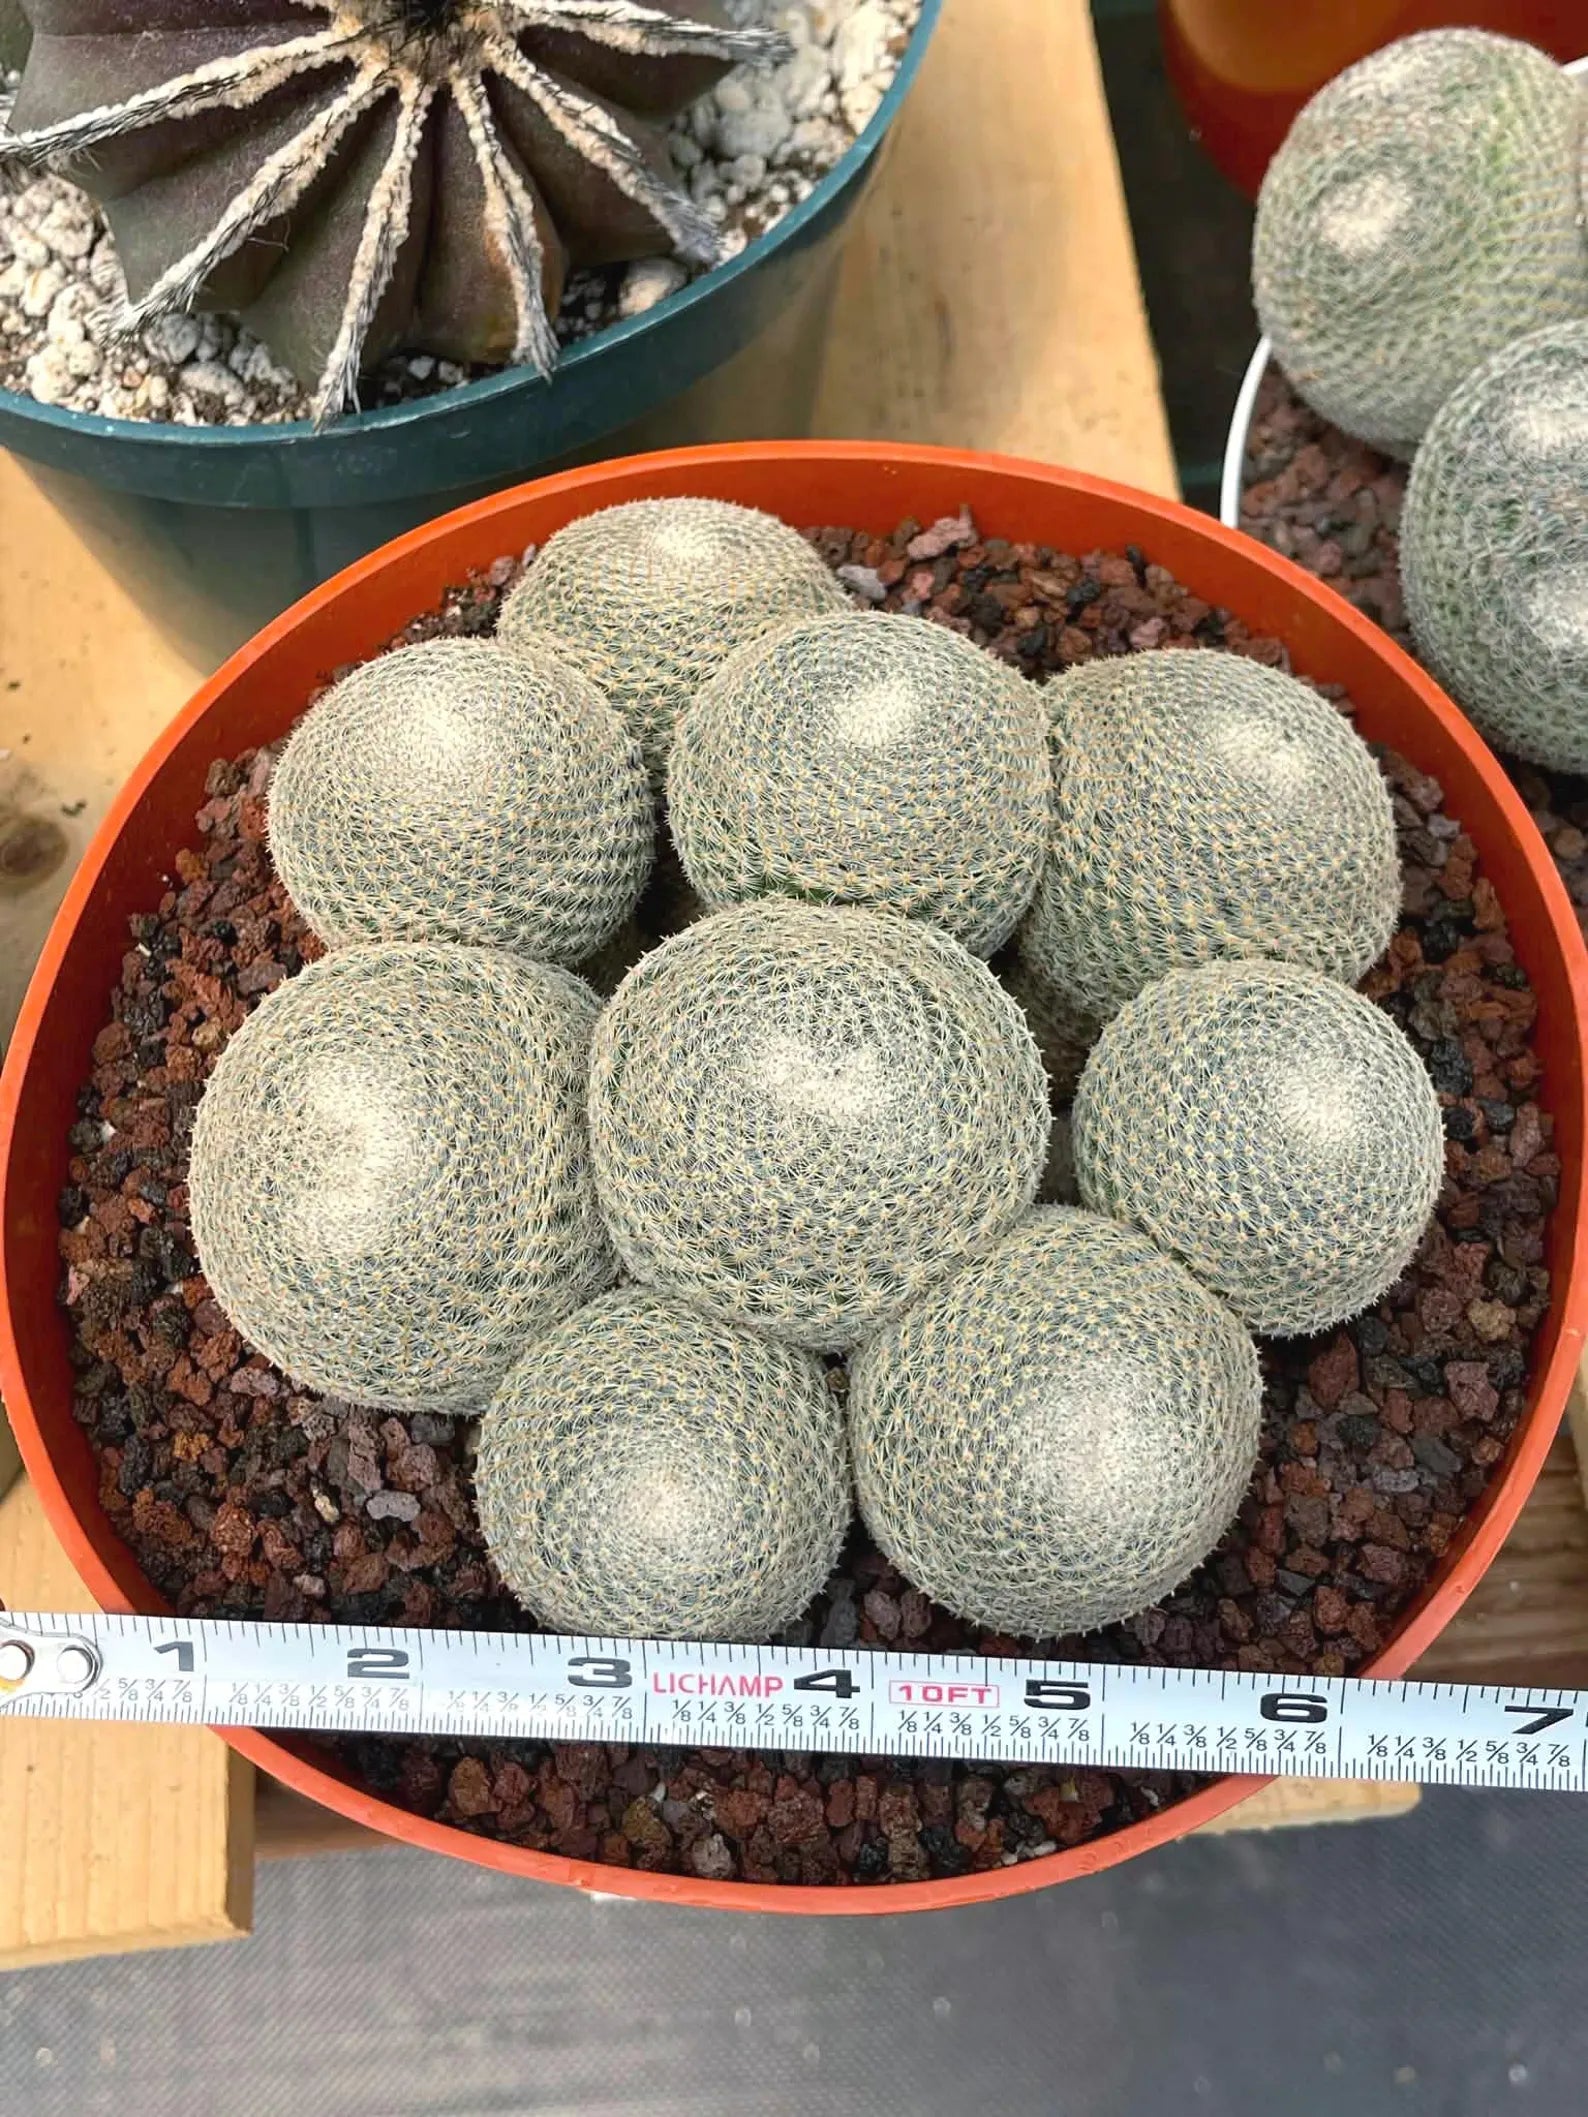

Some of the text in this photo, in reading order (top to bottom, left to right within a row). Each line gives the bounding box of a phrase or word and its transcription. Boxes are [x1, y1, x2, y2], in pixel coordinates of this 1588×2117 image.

[154, 1641, 194, 1672] 1
[347, 1648, 409, 1679] 2
[568, 1657, 632, 1688] 3
[653, 1672, 783, 1698] LICHAMP
[794, 1669, 860, 1699] 4
[898, 1685, 992, 1704] 10FT
[1024, 1679, 1091, 1710] 5
[1260, 1693, 1327, 1723] 6
[1504, 1705, 1574, 1735] 7
